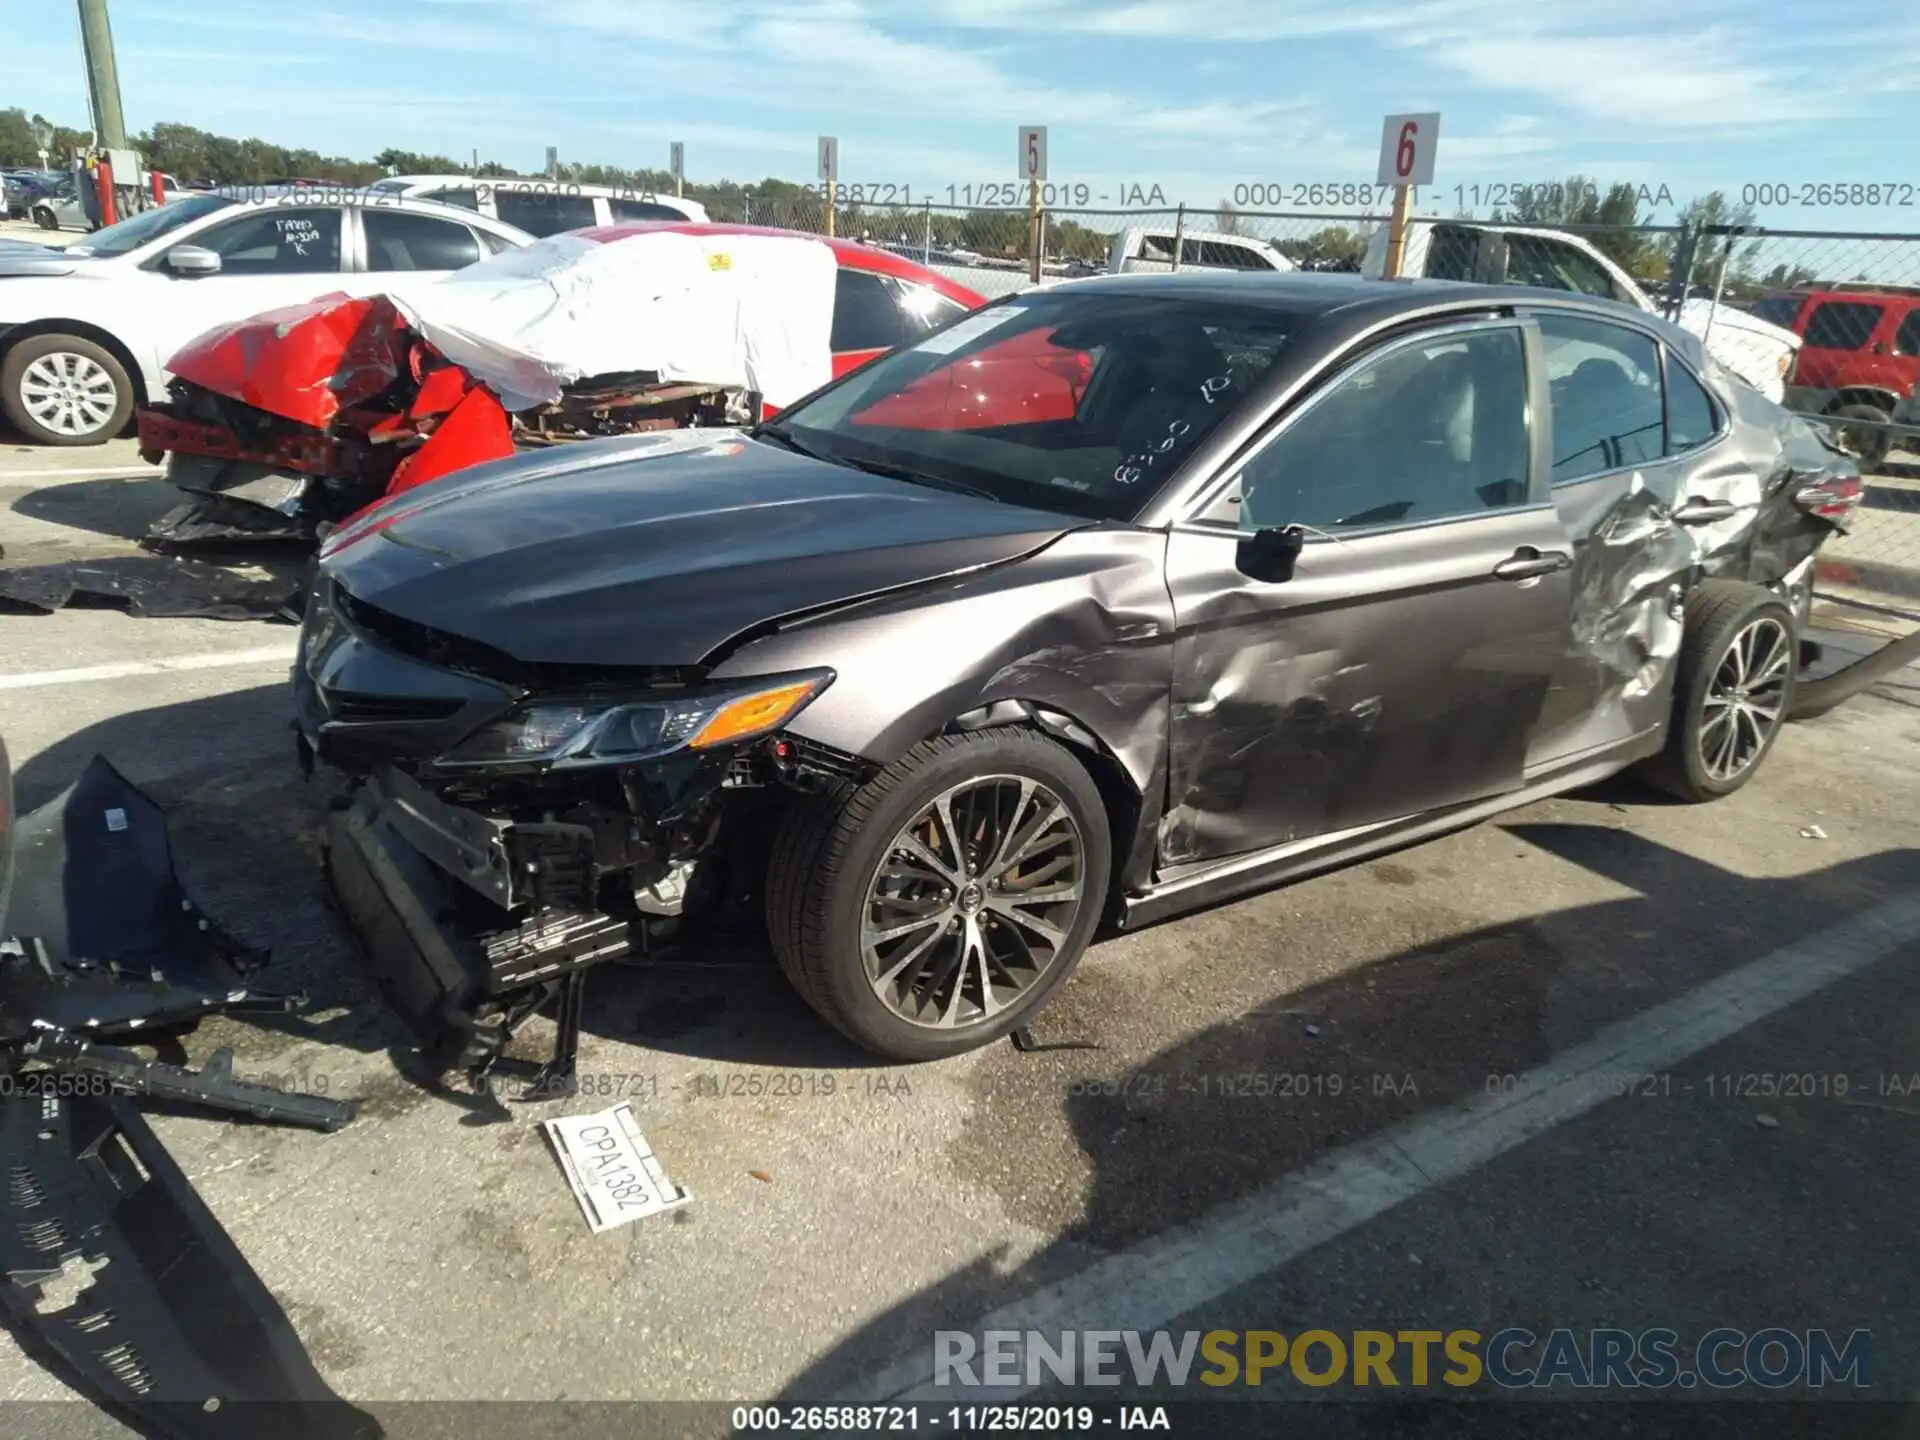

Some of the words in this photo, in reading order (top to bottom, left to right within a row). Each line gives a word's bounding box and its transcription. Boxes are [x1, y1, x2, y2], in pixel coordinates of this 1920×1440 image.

[822, 141, 831, 177] 4
[1028, 133, 1039, 174] 5
[1395, 121, 1418, 177] 6
[578, 1125, 650, 1211] CPA1382
